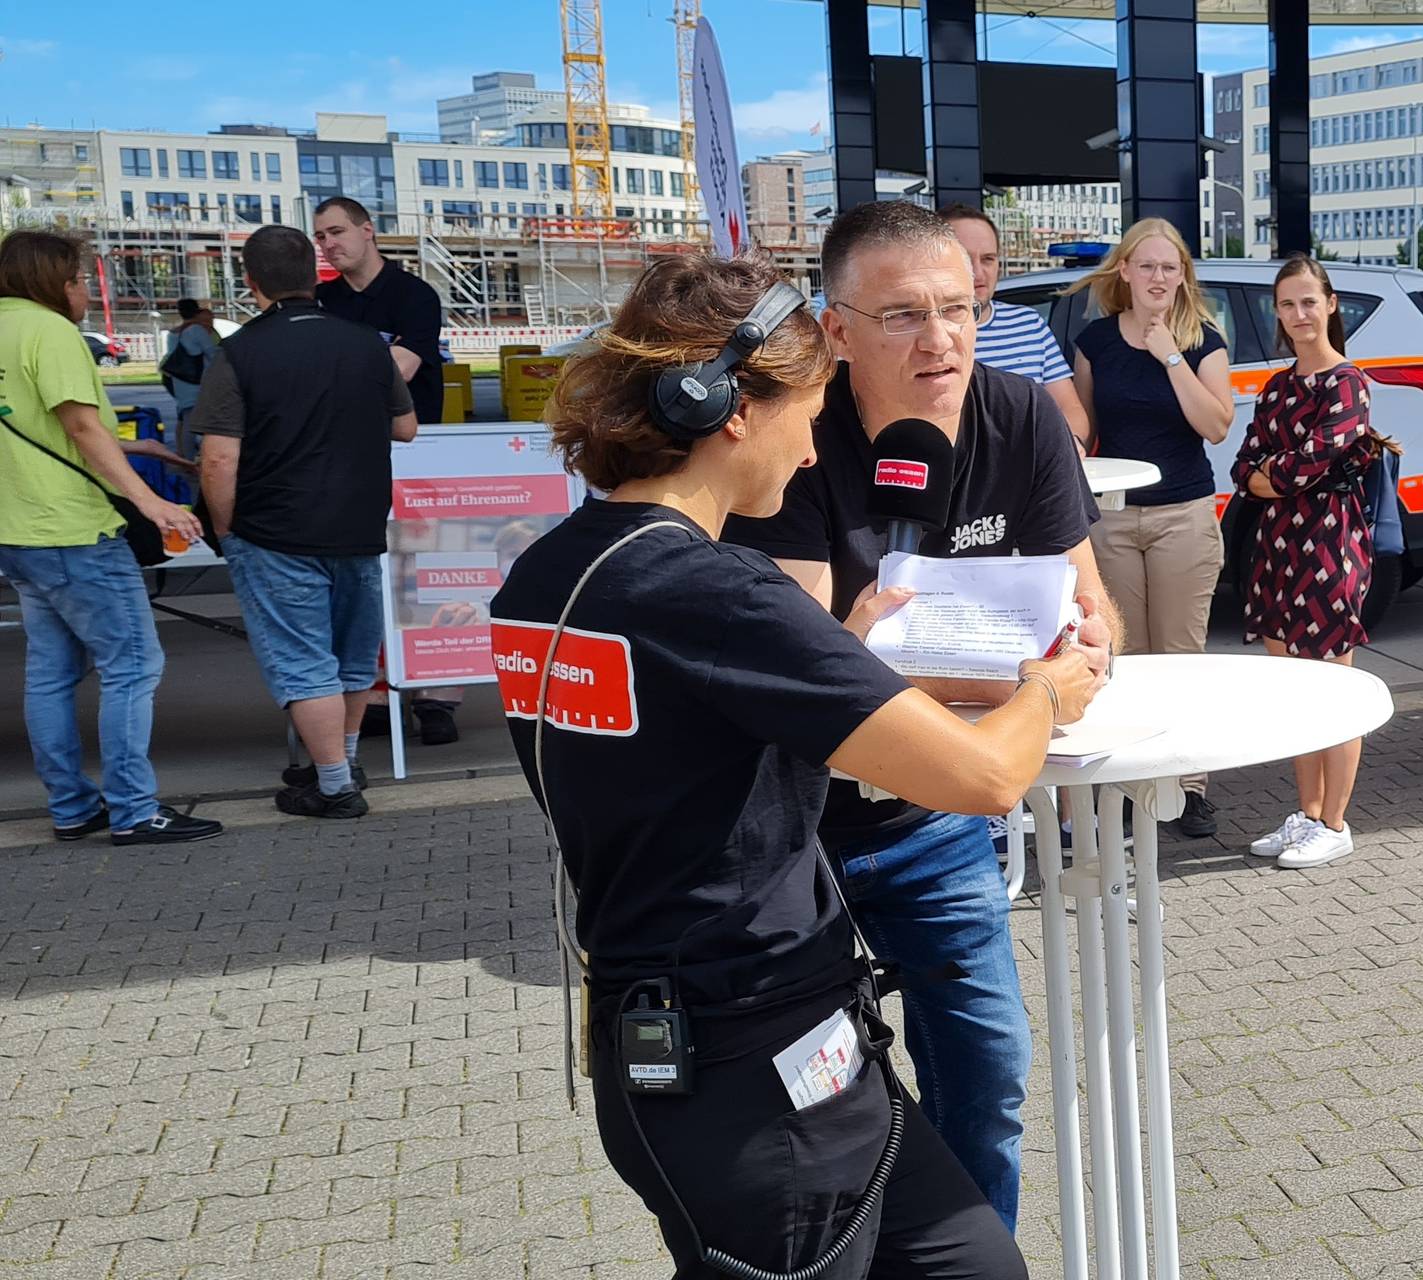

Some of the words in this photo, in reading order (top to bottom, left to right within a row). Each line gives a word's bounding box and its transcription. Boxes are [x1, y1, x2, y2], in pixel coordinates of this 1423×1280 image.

[404, 495, 434, 508] Lust
[436, 494, 457, 507] auf
[460, 491, 532, 505] Ehrenamt?
[950, 527, 1005, 554] JONES
[428, 571, 488, 585] DANKE
